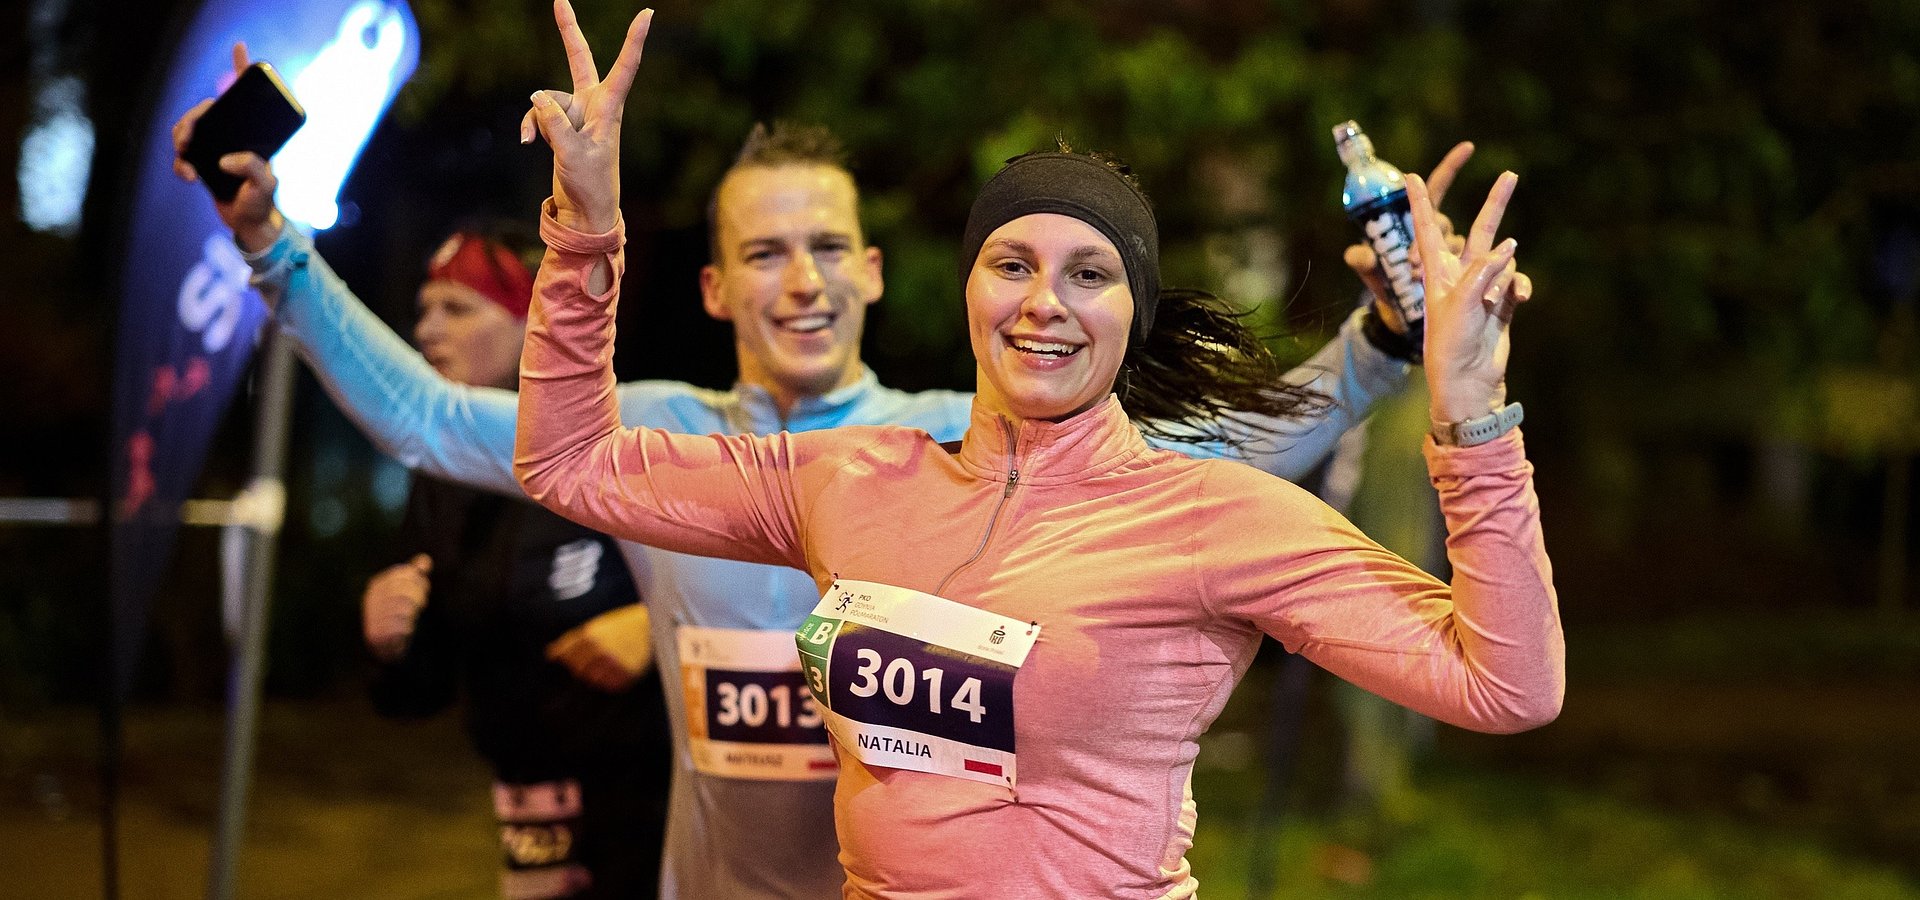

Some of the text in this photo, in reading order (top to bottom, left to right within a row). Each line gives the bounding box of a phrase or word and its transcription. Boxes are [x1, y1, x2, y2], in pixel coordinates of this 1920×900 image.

[859, 594, 872, 602] PKO
[809, 622, 834, 645] B
[810, 666, 824, 693] 3
[849, 648, 987, 724] 3014
[715, 681, 825, 729] 3013
[858, 733, 932, 759] NATALIA
